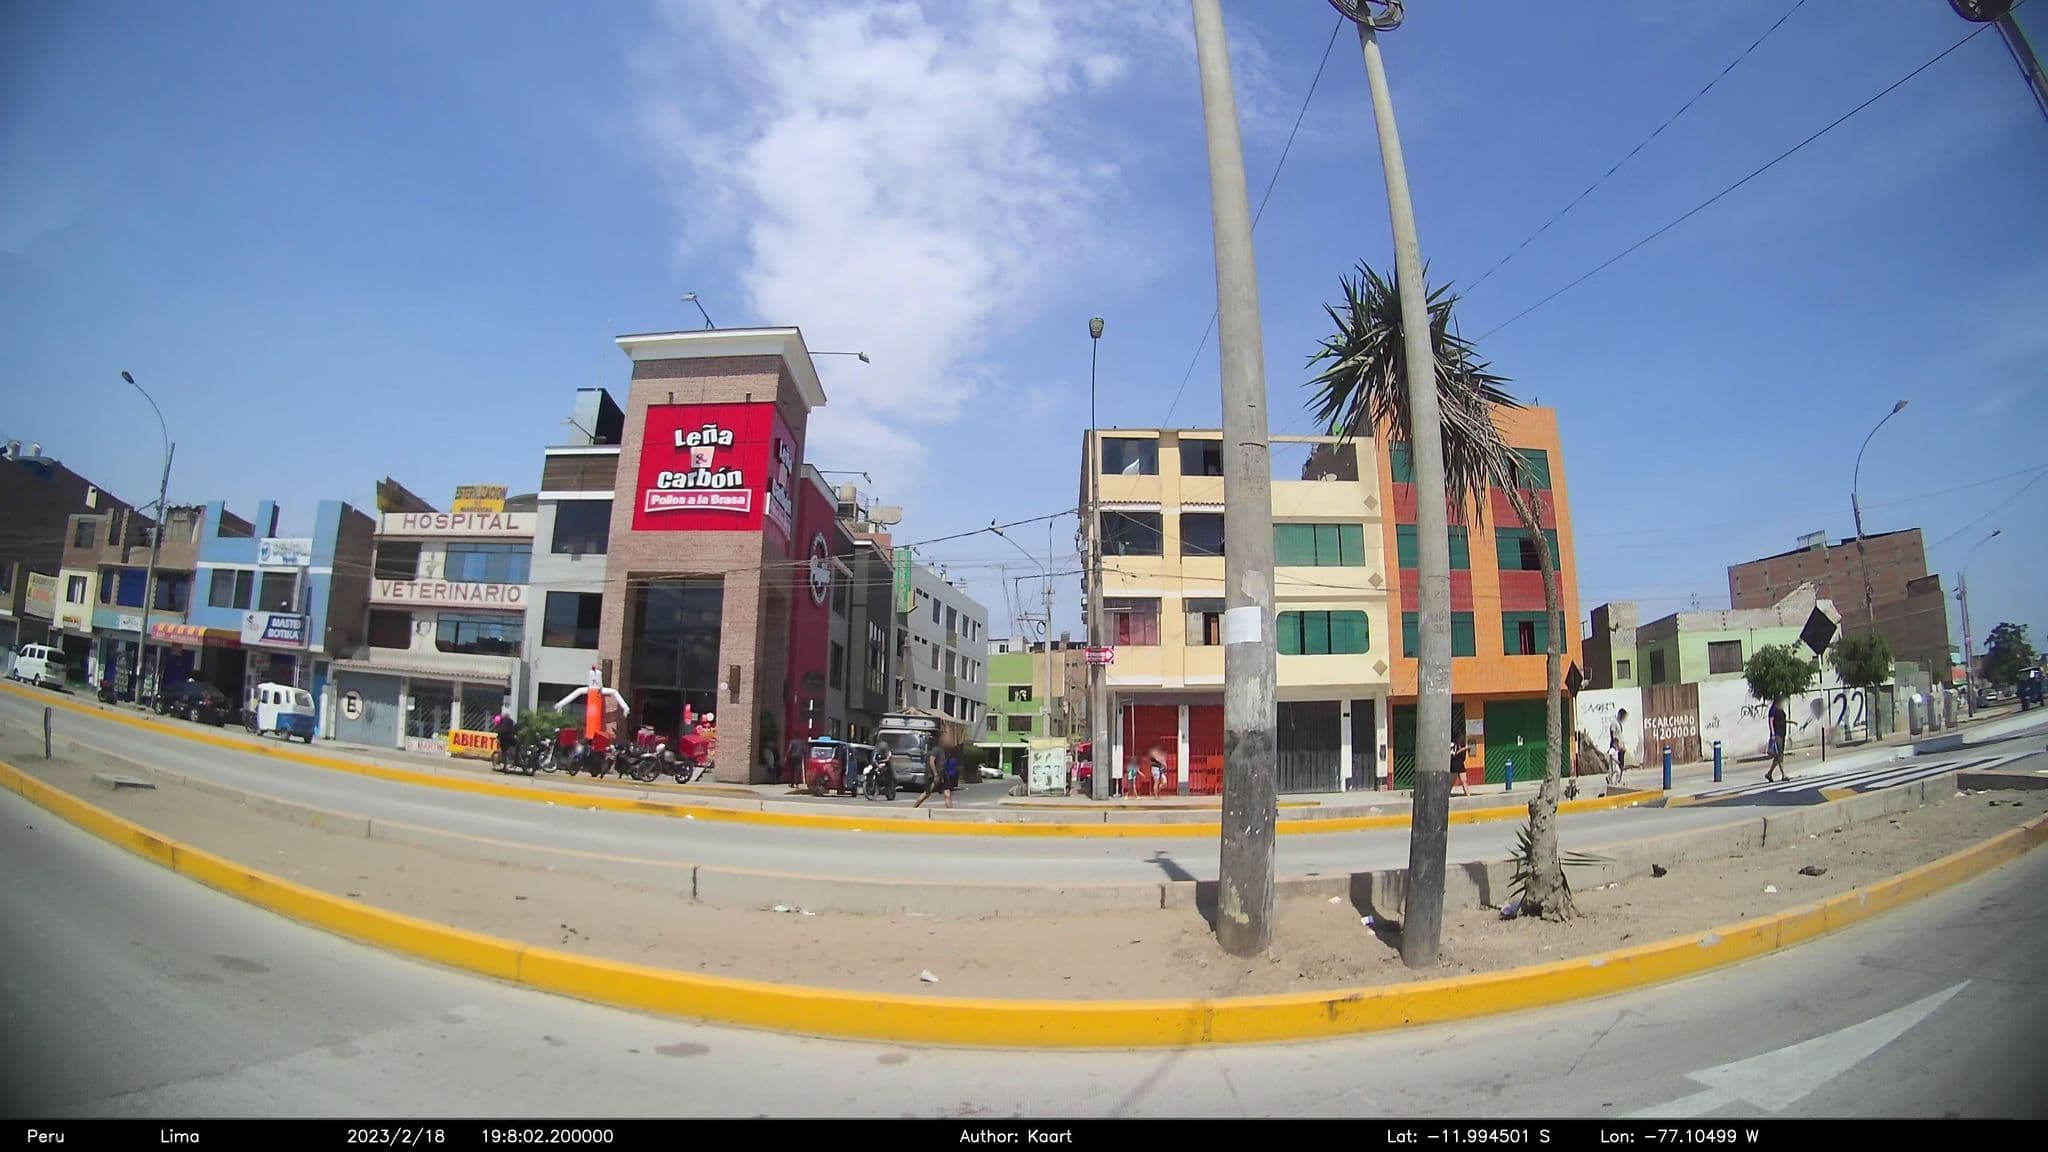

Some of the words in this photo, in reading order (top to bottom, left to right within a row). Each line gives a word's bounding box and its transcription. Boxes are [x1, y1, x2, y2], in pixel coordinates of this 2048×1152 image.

[674, 424, 733, 447] Leña
[657, 467, 743, 489] Carbón
[650, 495, 686, 505] Pollos
[687, 496, 696, 505] a
[697, 494, 709, 505] la
[711, 495, 746, 505] Brasa
[403, 513, 519, 530] HOSPITAL
[382, 581, 521, 603] VETERINARIO
[347, 695, 357, 713] E
[1643, 714, 1695, 729] ESCARCHADO
[453, 732, 501, 750] ABIERT
[1653, 726, 1696, 741] 4209000
